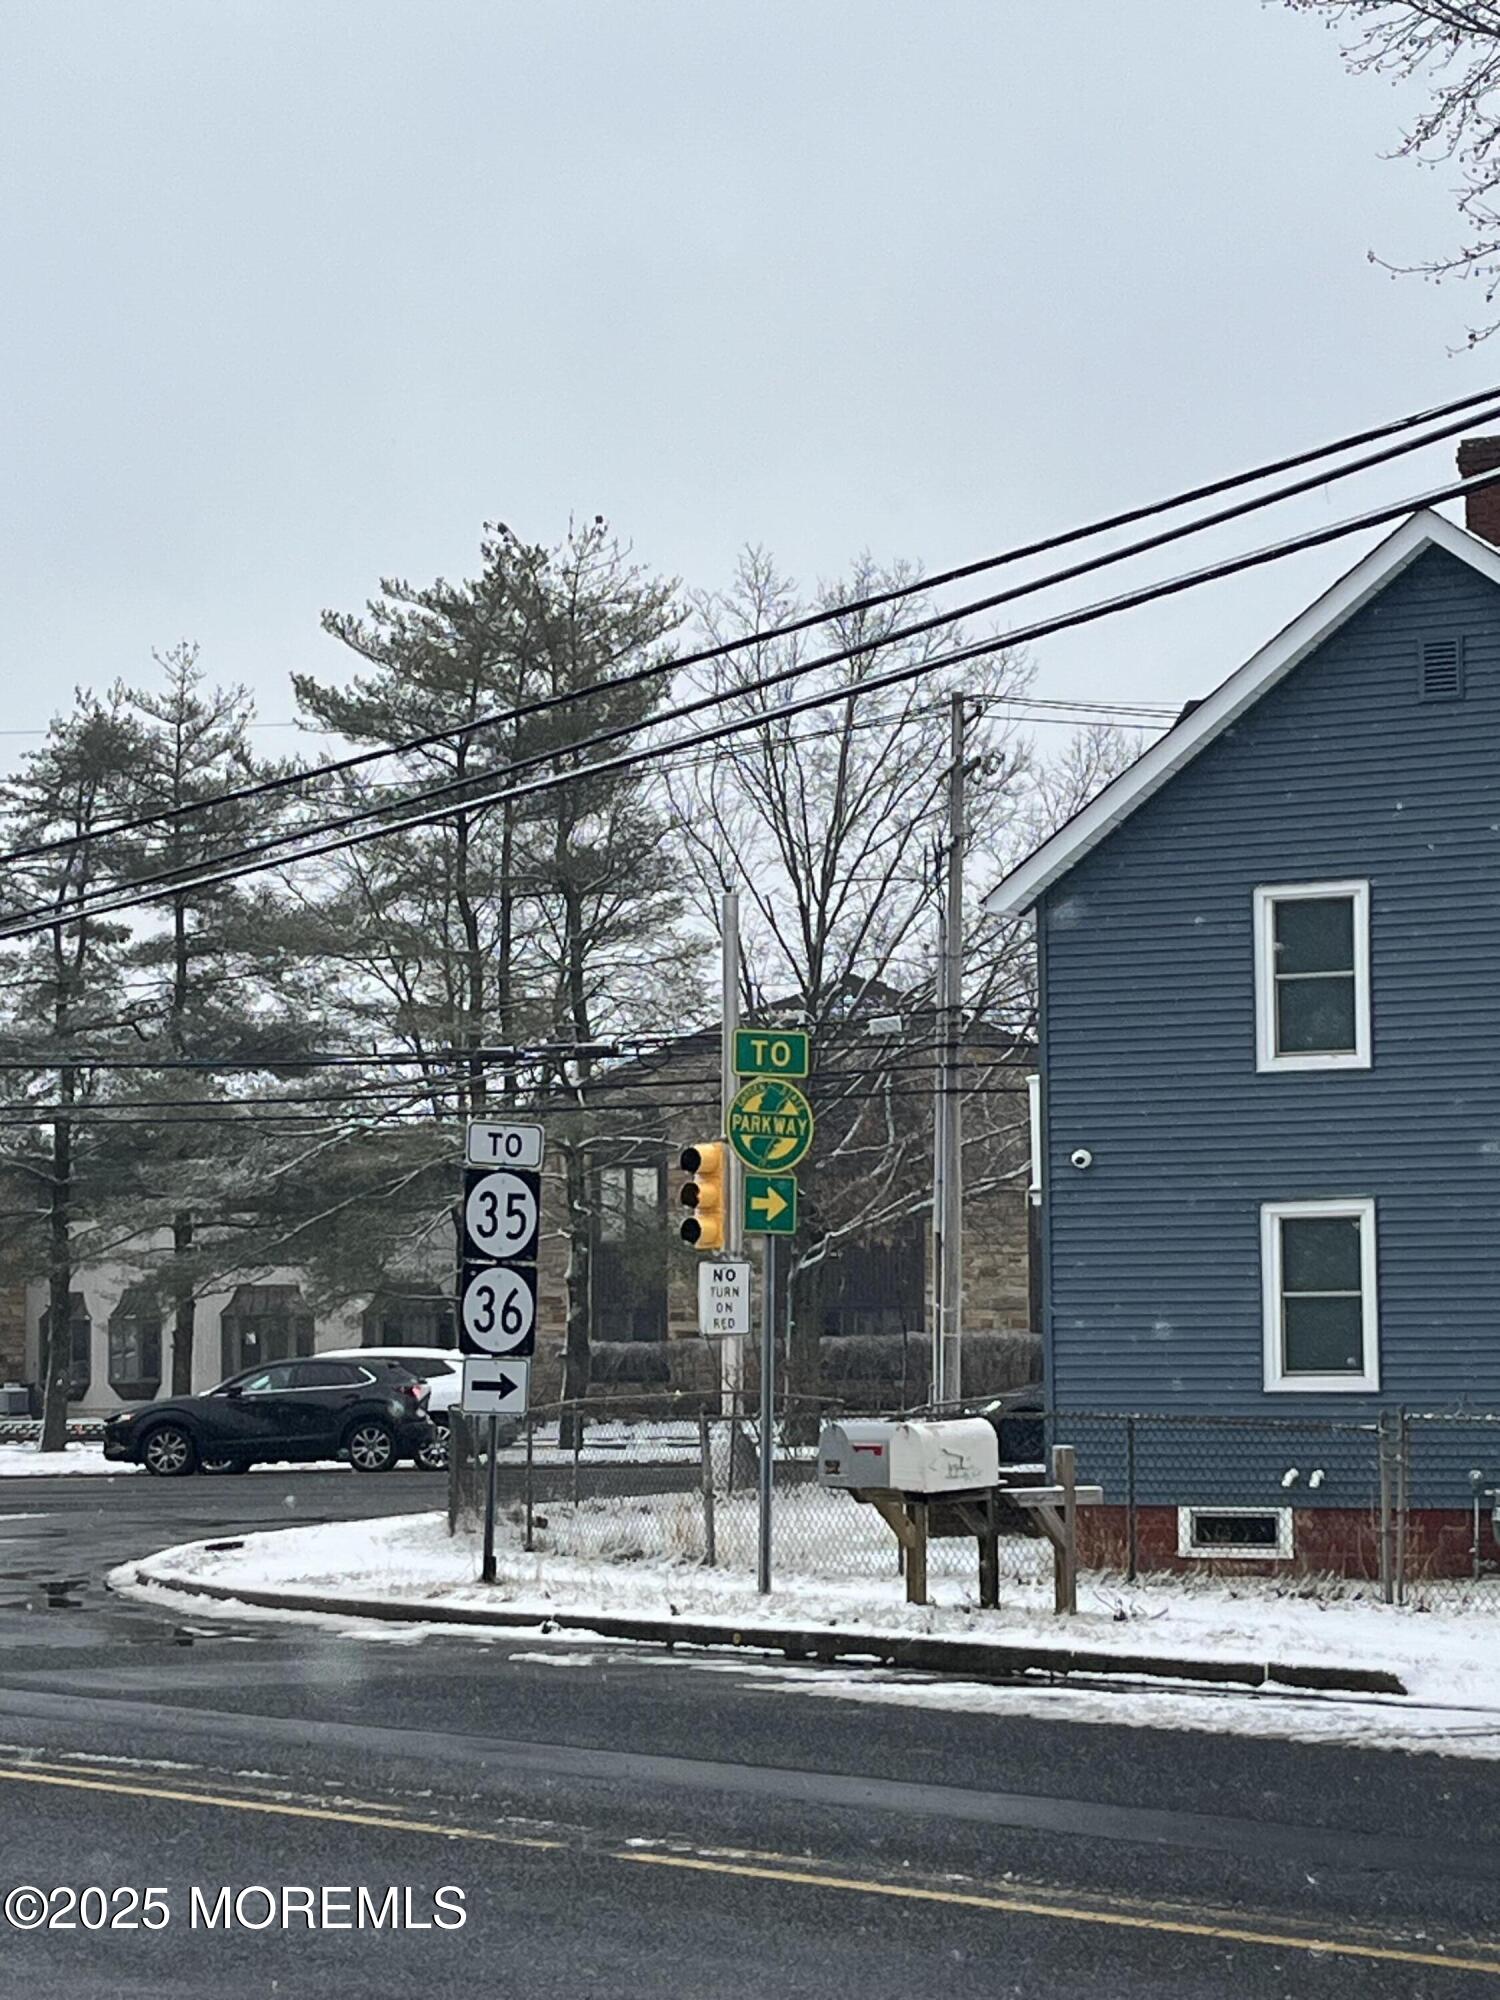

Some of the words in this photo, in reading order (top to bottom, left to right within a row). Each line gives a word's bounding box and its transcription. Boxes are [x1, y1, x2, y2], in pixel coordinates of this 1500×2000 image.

[750, 1040, 791, 1067] TO
[732, 1113, 807, 1136] PARKWAY
[488, 1132, 523, 1158] TO
[476, 1191, 527, 1240] 35
[713, 1268, 736, 1282] NO
[710, 1286, 740, 1298] TURN
[473, 1286, 523, 1335] 36
[716, 1302, 733, 1313] ON
[713, 1318, 736, 1330] RED
